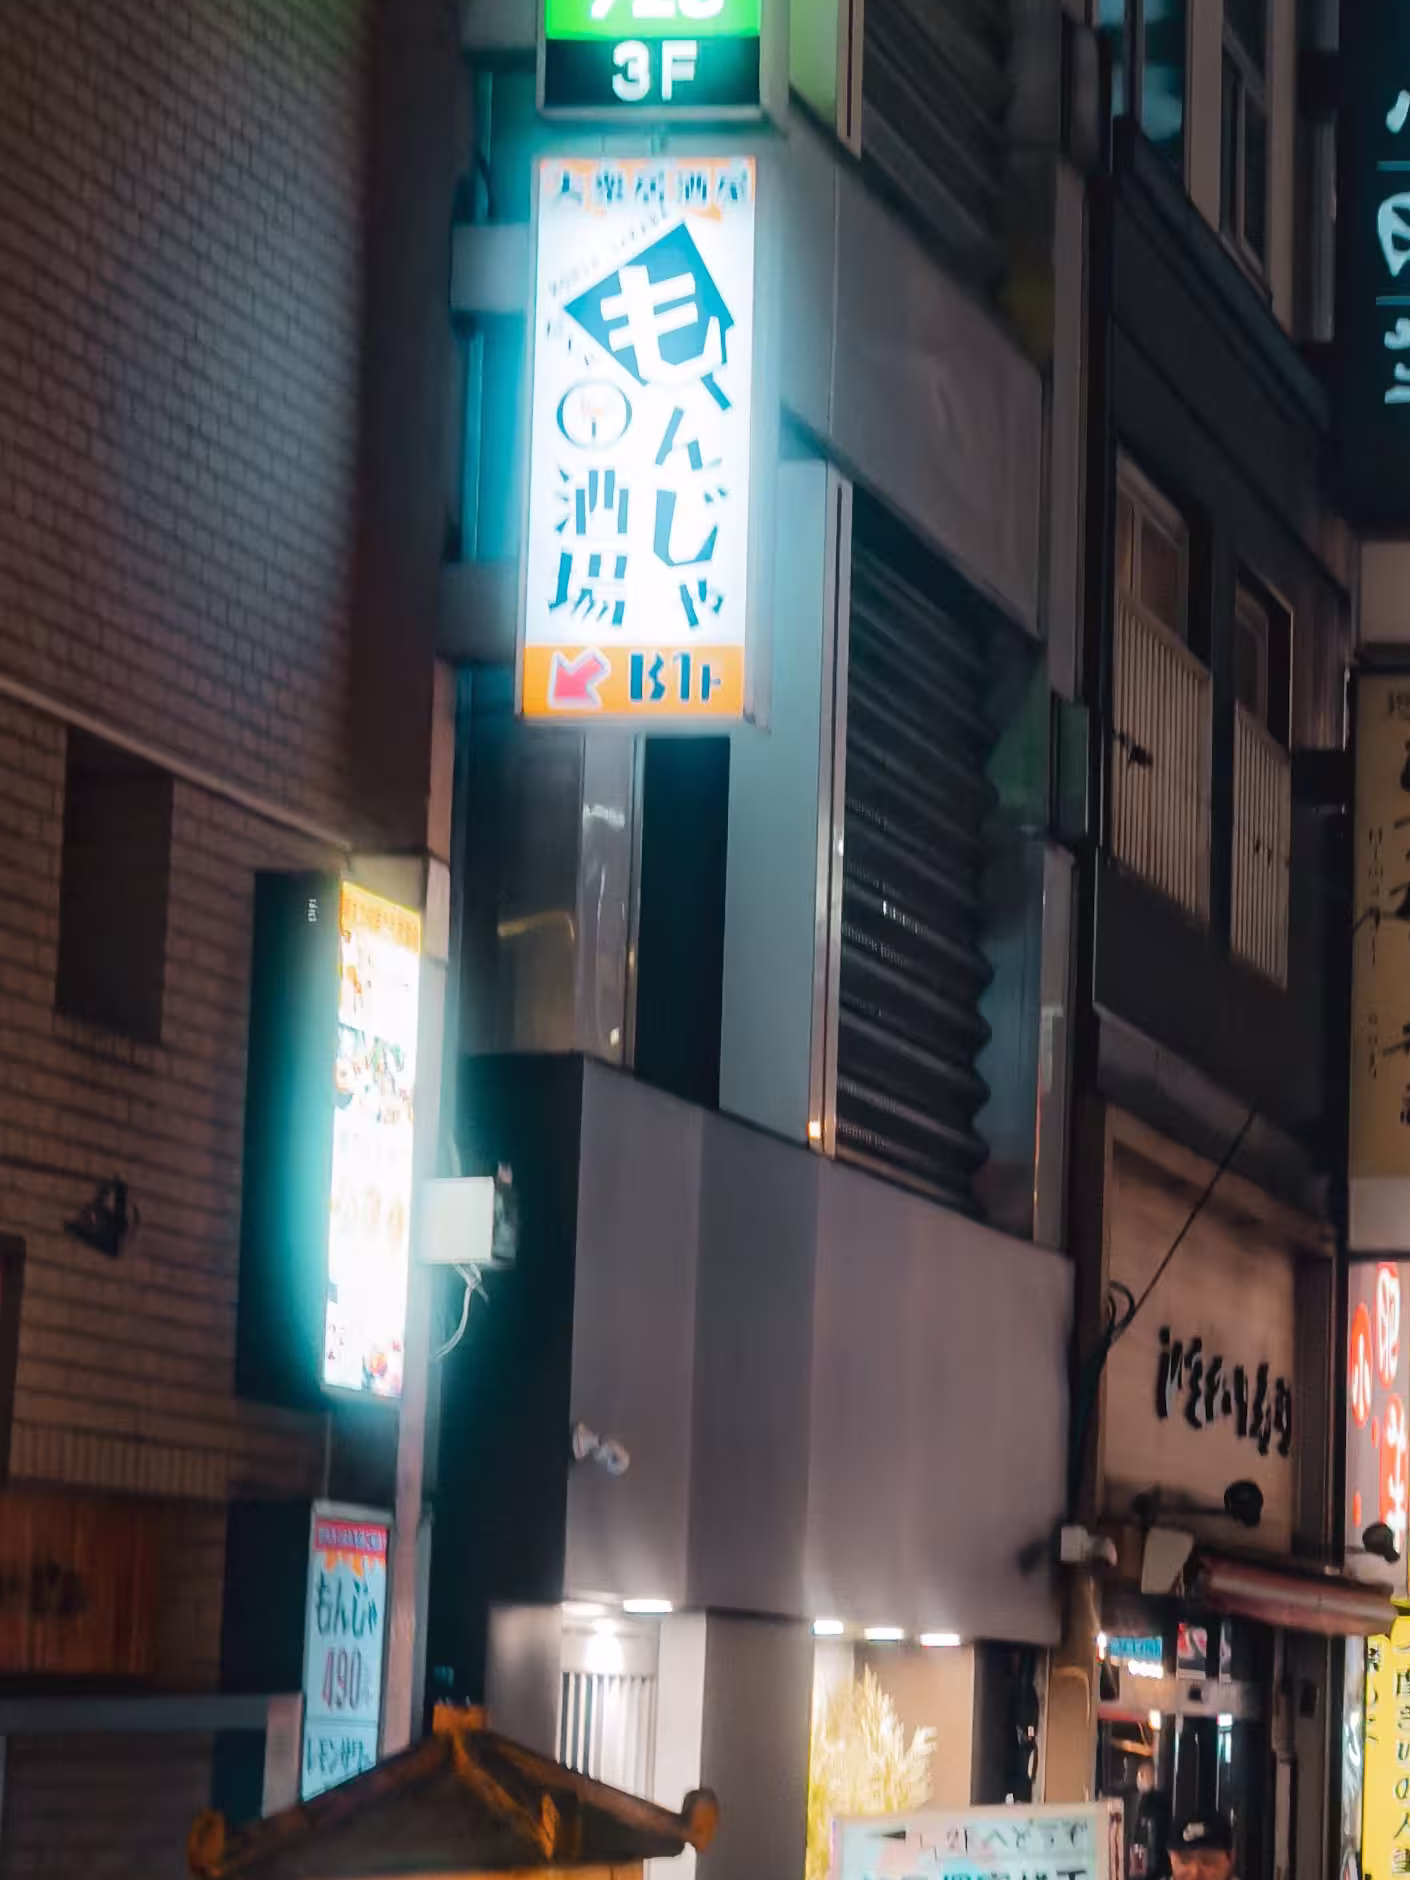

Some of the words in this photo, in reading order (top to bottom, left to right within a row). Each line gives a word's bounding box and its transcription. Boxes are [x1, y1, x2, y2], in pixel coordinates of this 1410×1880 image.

[612, 39, 698, 102] 3F
[314, 1570, 379, 1638] もんじゃ
[321, 1646, 362, 1710] 490
